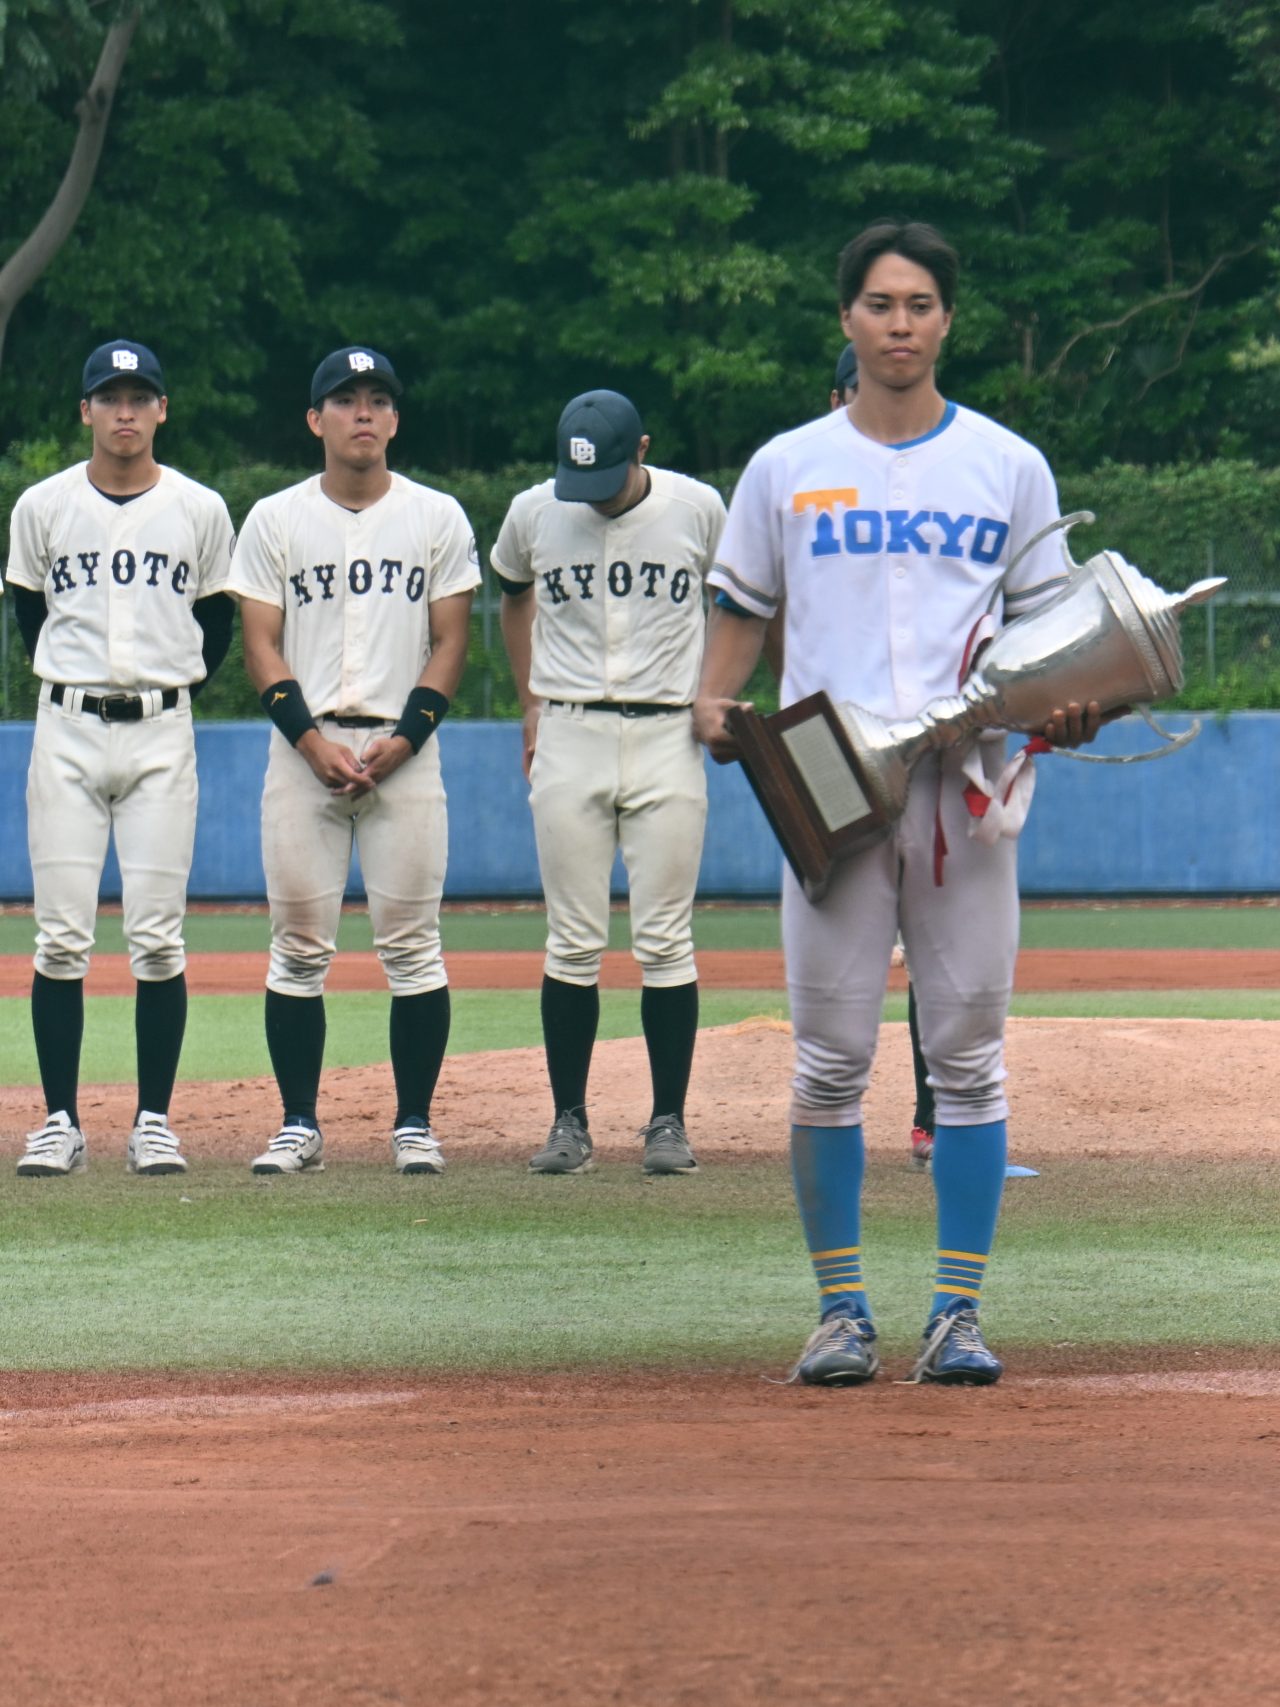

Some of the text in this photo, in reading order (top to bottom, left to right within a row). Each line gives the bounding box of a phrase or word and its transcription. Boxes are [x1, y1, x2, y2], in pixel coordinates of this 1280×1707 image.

[793, 488, 1009, 564] TOKYO
[52, 549, 190, 594] KYOTO
[290, 558, 425, 607] KYOTO
[543, 561, 690, 605] KYOTO
